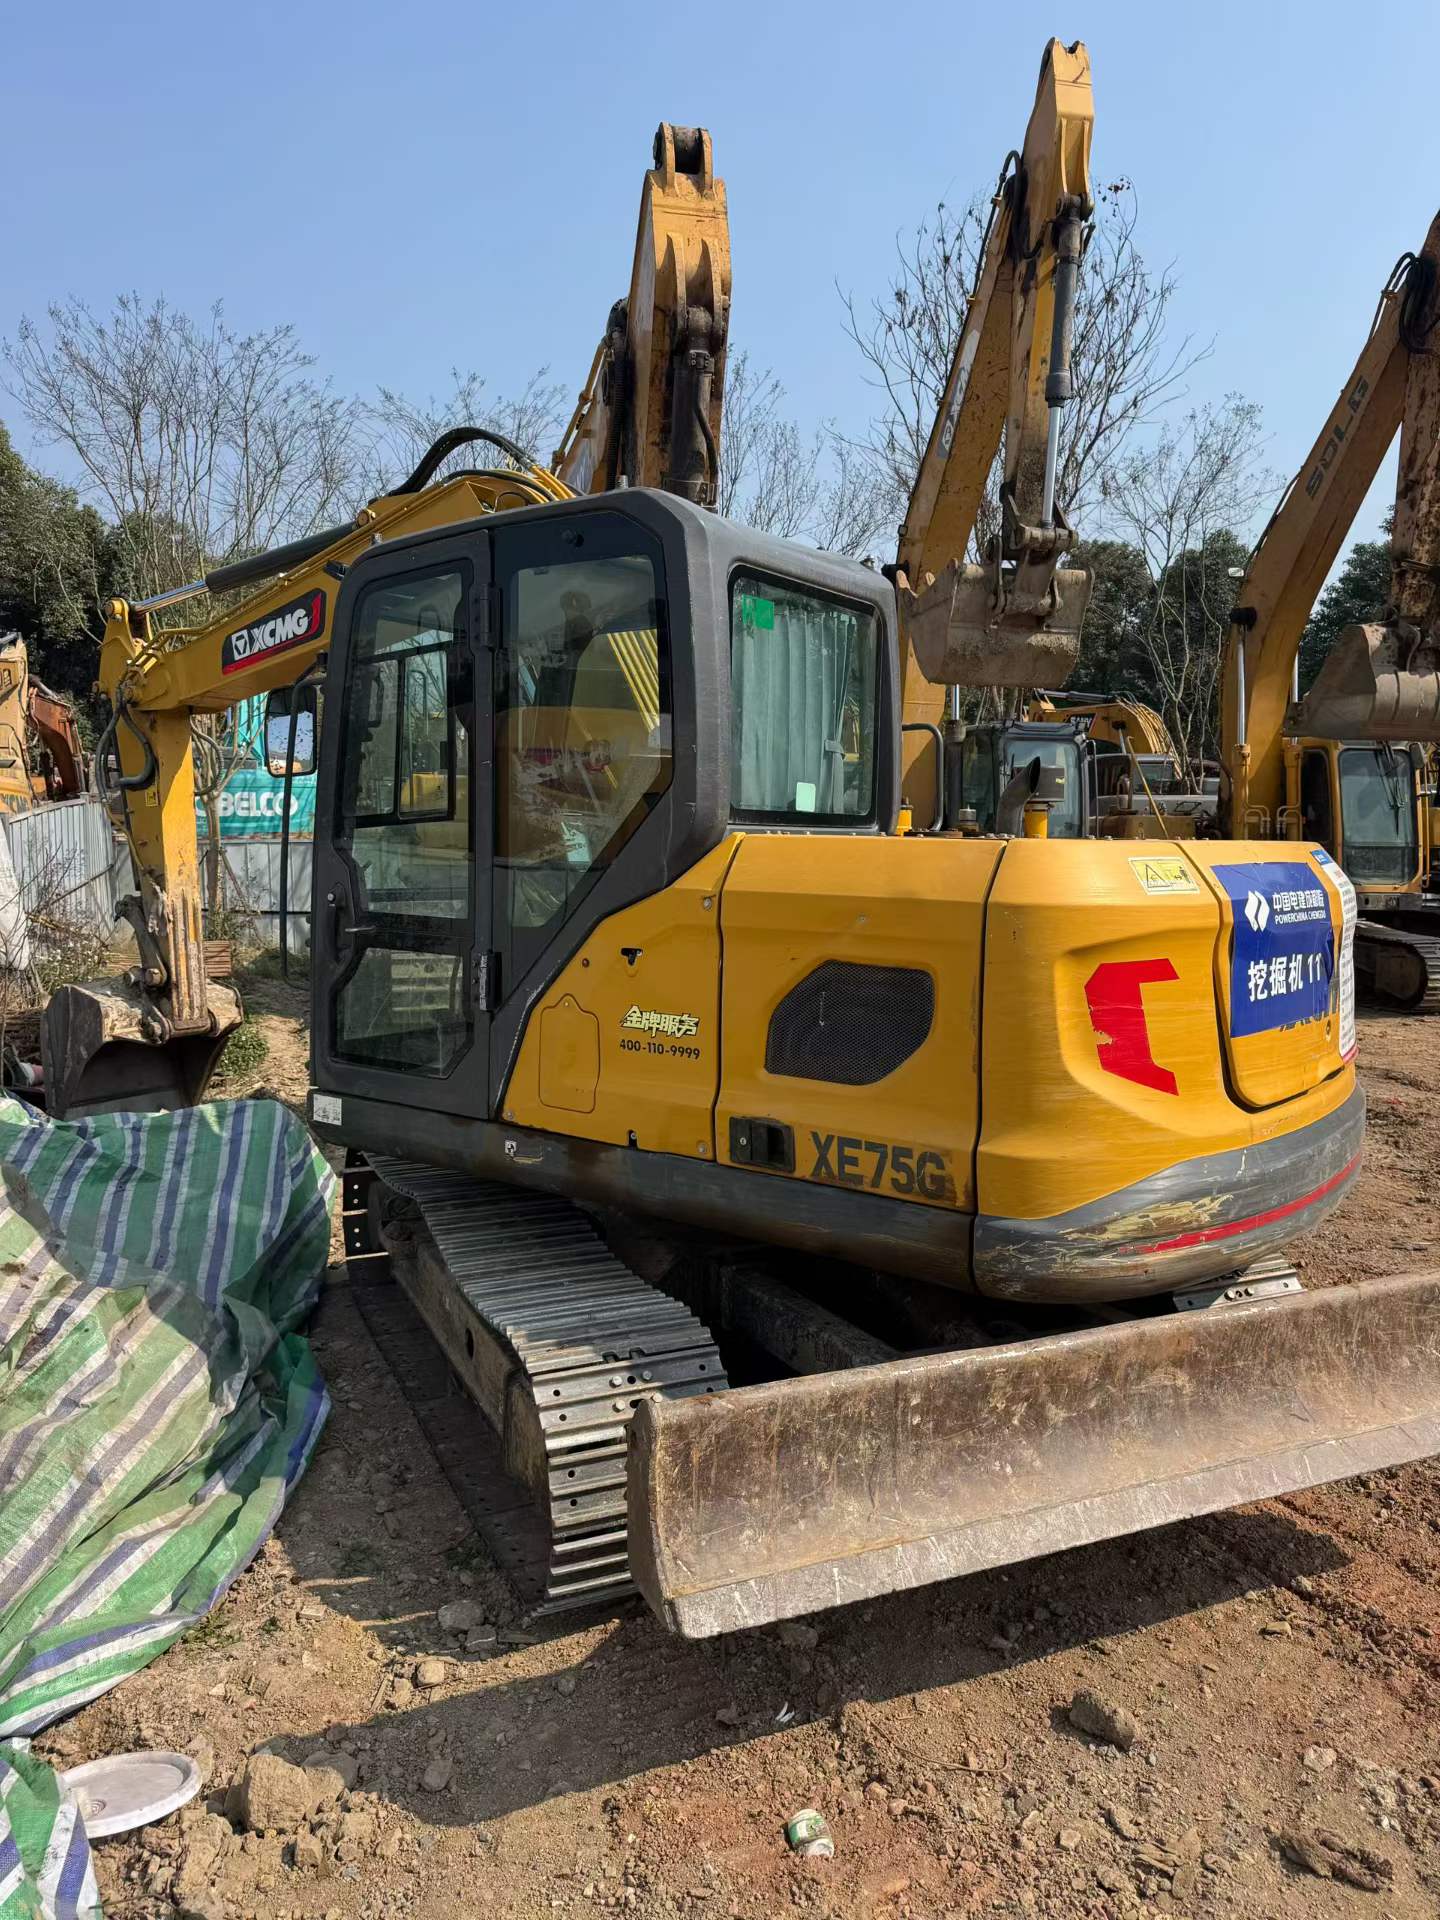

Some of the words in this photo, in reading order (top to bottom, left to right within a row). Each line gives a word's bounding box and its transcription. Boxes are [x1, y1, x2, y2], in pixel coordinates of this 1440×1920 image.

[250, 608, 309, 655] XCMG
[1248, 953, 1304, 1002] 挖掘机
[1308, 953, 1322, 984] 11
[620, 1005, 701, 1038] 金牌服务
[620, 1039, 700, 1060] 400-110-9999
[810, 1130, 946, 1200] XE75G
